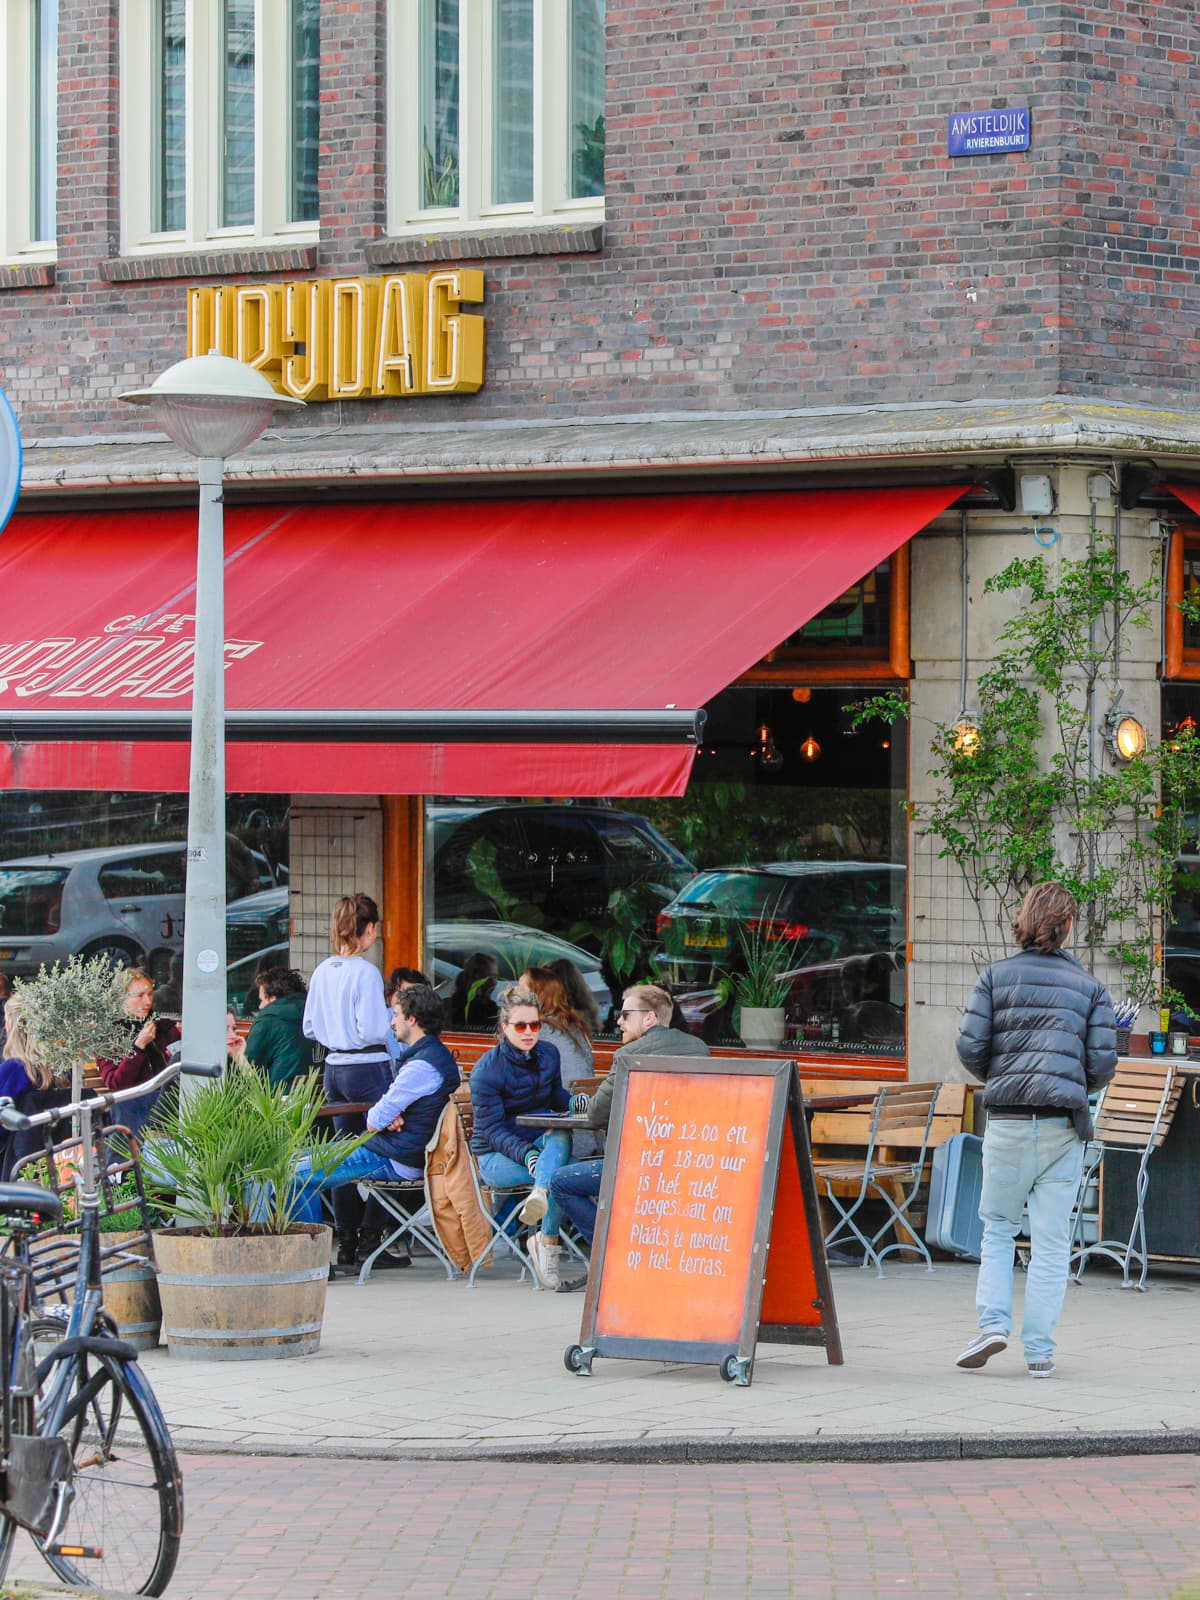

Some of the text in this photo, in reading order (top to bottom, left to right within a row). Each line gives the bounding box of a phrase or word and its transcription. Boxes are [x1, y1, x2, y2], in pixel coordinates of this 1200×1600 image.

[951, 113, 1025, 135] AMSTELDIJK
[966, 134, 1025, 149] RIVIERENBUURT
[679, 1123, 718, 1142] 12:00
[726, 1124, 749, 1144] en
[673, 1150, 715, 1169] 18:00
[719, 1155, 746, 1171] uur
[637, 1171, 719, 1199] is het niet
[712, 1205, 733, 1224] om
[673, 1223, 685, 1248] te
[689, 1232, 731, 1252] nemen
[627, 1248, 726, 1278] op het terras.
